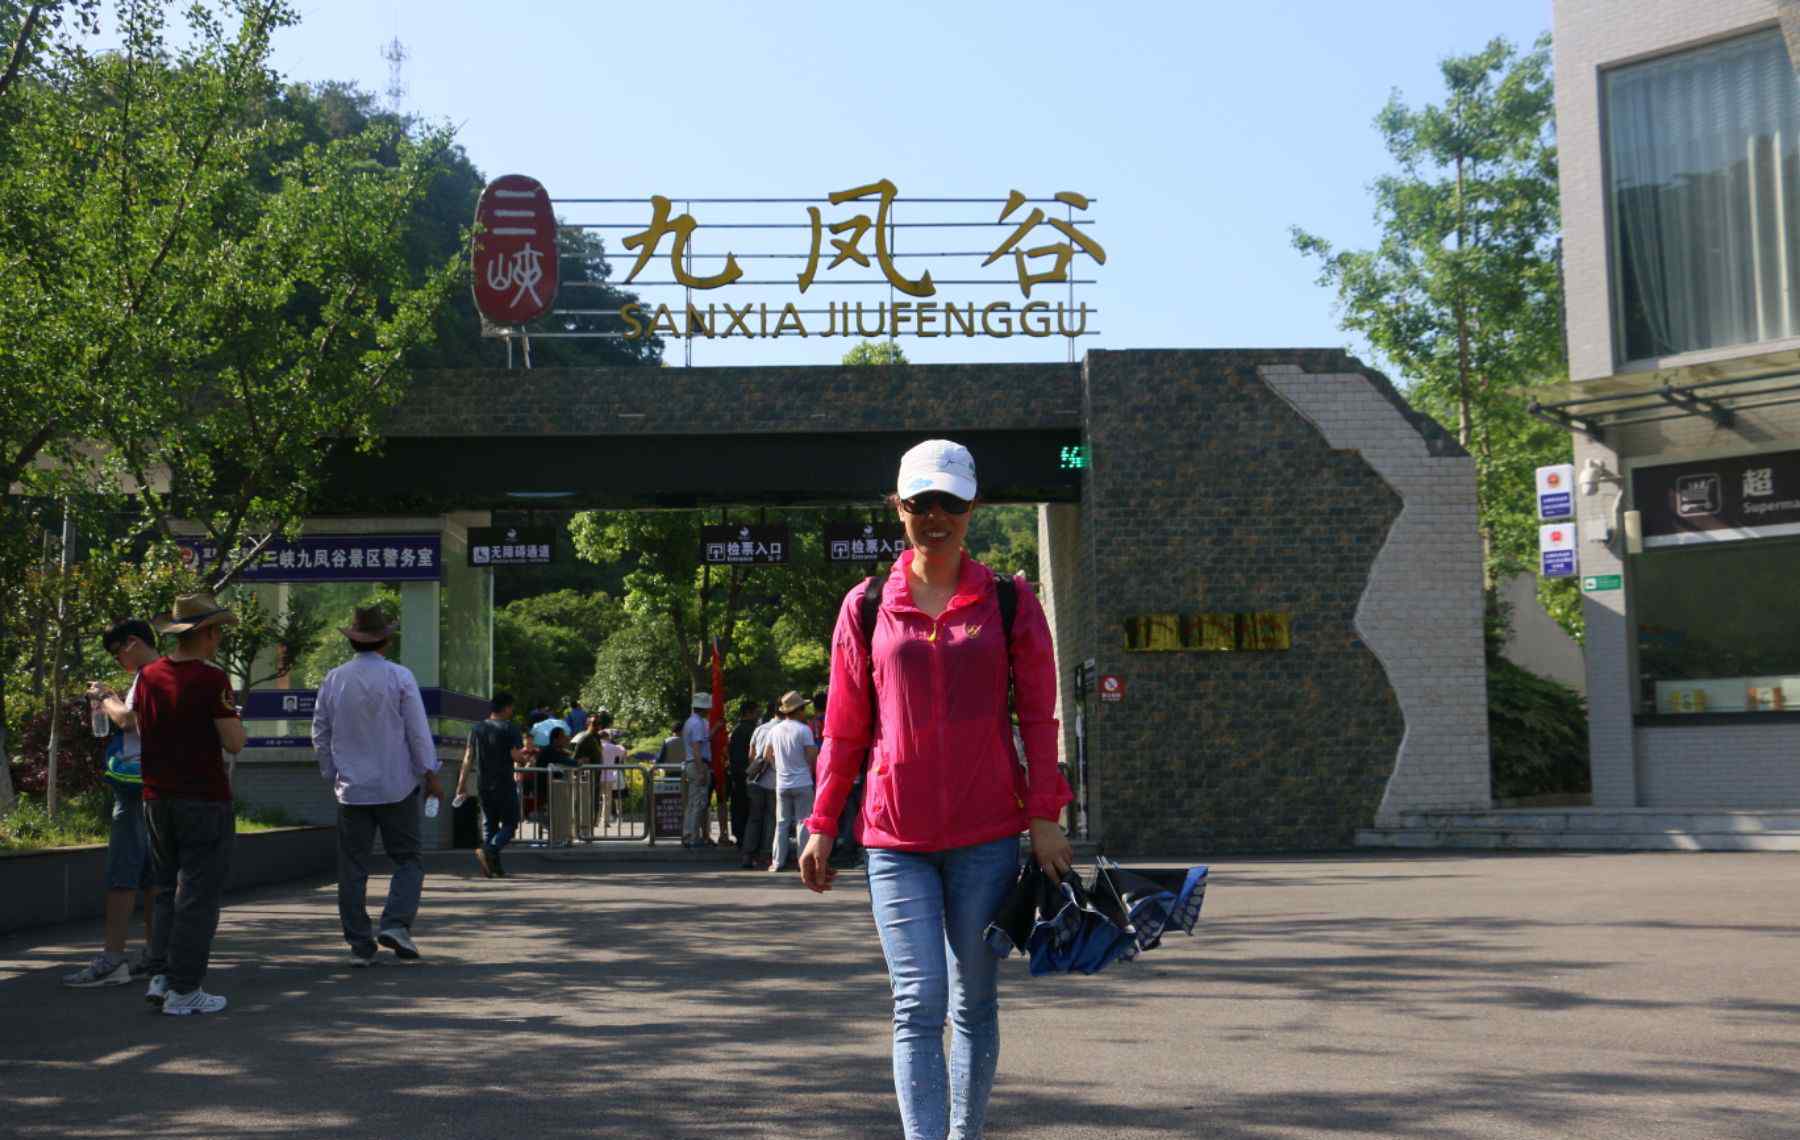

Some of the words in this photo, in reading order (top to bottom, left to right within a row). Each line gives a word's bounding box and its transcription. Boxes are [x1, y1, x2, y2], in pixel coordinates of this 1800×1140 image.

[621, 178, 1106, 300] 九凤谷
[619, 302, 809, 339] SANXIA
[820, 301, 1087, 338] JIUFENGGU
[1742, 467, 1775, 499] 超
[491, 544, 551, 559] 无障碍通道
[727, 542, 782, 556] 检票入口
[852, 538, 905, 554] 检票入口
[261, 548, 433, 569] 三峡九凤谷景区警务室
